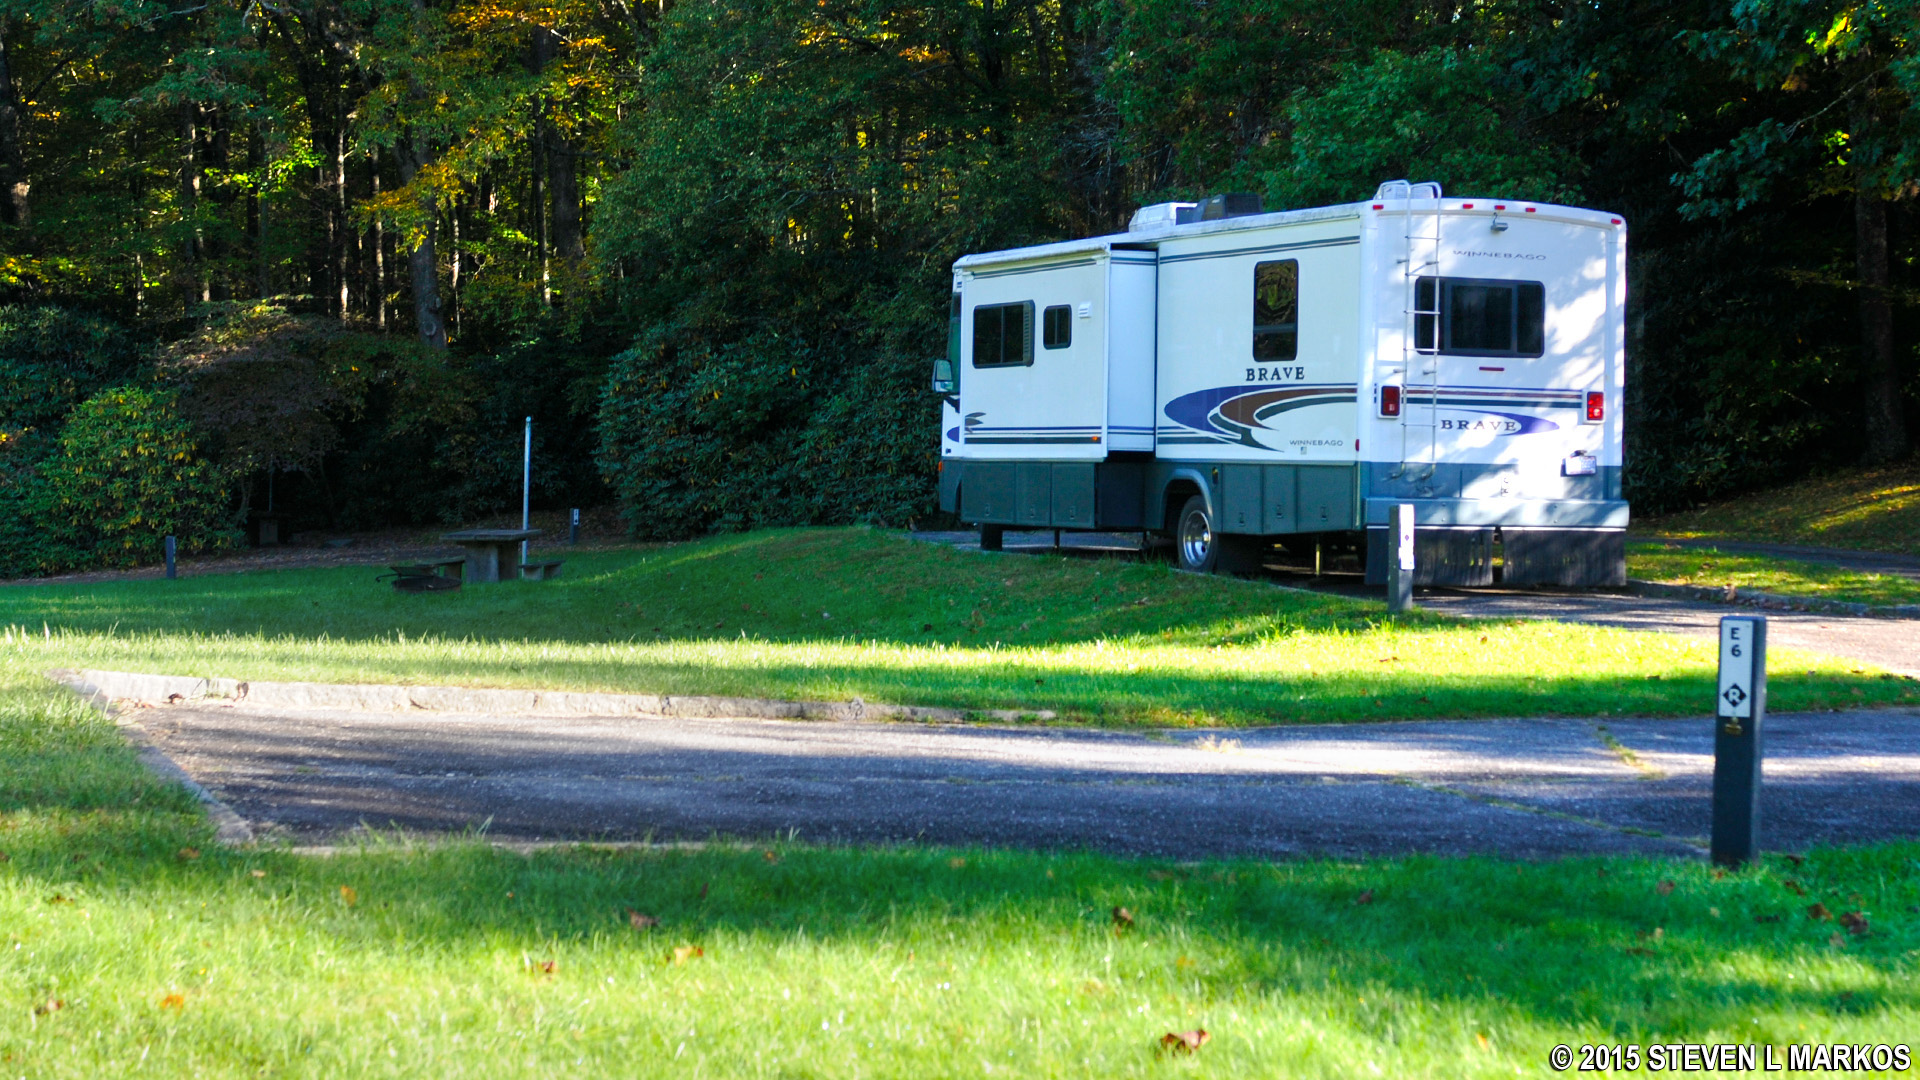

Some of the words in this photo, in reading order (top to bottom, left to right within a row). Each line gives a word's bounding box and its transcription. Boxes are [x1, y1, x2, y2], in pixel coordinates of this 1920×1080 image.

[1453, 250, 1547, 260] WINNEBAGO
[1246, 367, 1305, 381] BRAVE
[1441, 420, 1517, 431] BRAVE
[1730, 627, 1740, 640] E
[1731, 644, 1742, 657] 6
